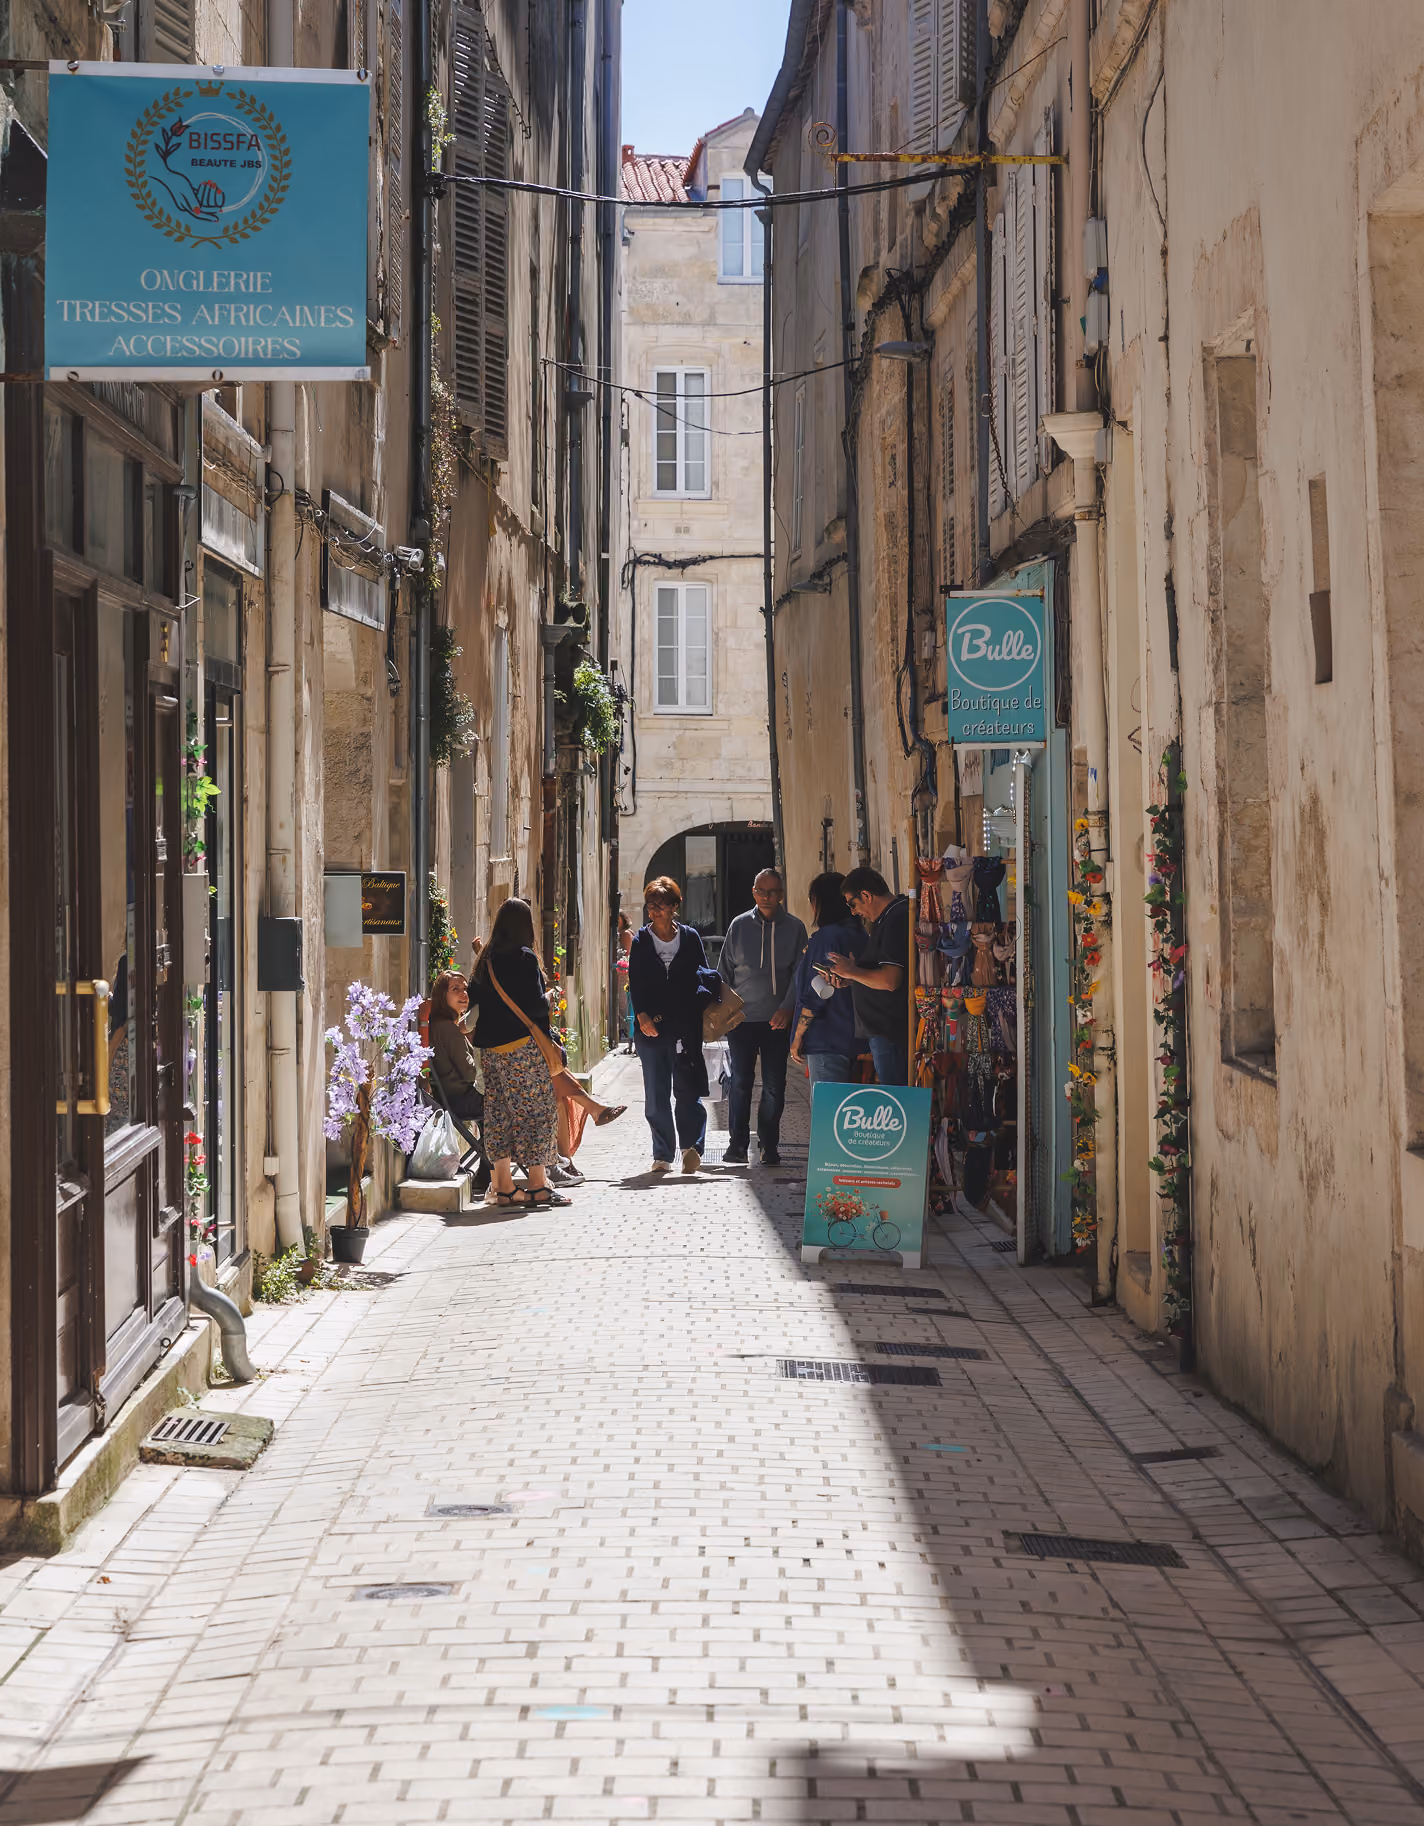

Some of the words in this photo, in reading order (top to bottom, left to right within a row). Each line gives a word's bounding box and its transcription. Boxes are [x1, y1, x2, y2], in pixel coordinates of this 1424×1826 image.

[188, 131, 261, 151] BISSFA
[191, 158, 237, 168] BEAUTE
[240, 160, 262, 169] JBS
[140, 269, 273, 293] ONGLERIE
[56, 300, 182, 324] TRESSES
[191, 303, 355, 328] AFRICAINES
[108, 335, 302, 360] ACCESSOIRES
[957, 624, 1034, 661] Bulle
[951, 688, 1020, 717] Boutique
[1024, 685, 1042, 710] de
[962, 719, 1035, 736] créateurs
[362, 877, 401, 892] Baltique
[362, 918, 402, 926] rtisanaux
[842, 1105, 902, 1131] Bulle
